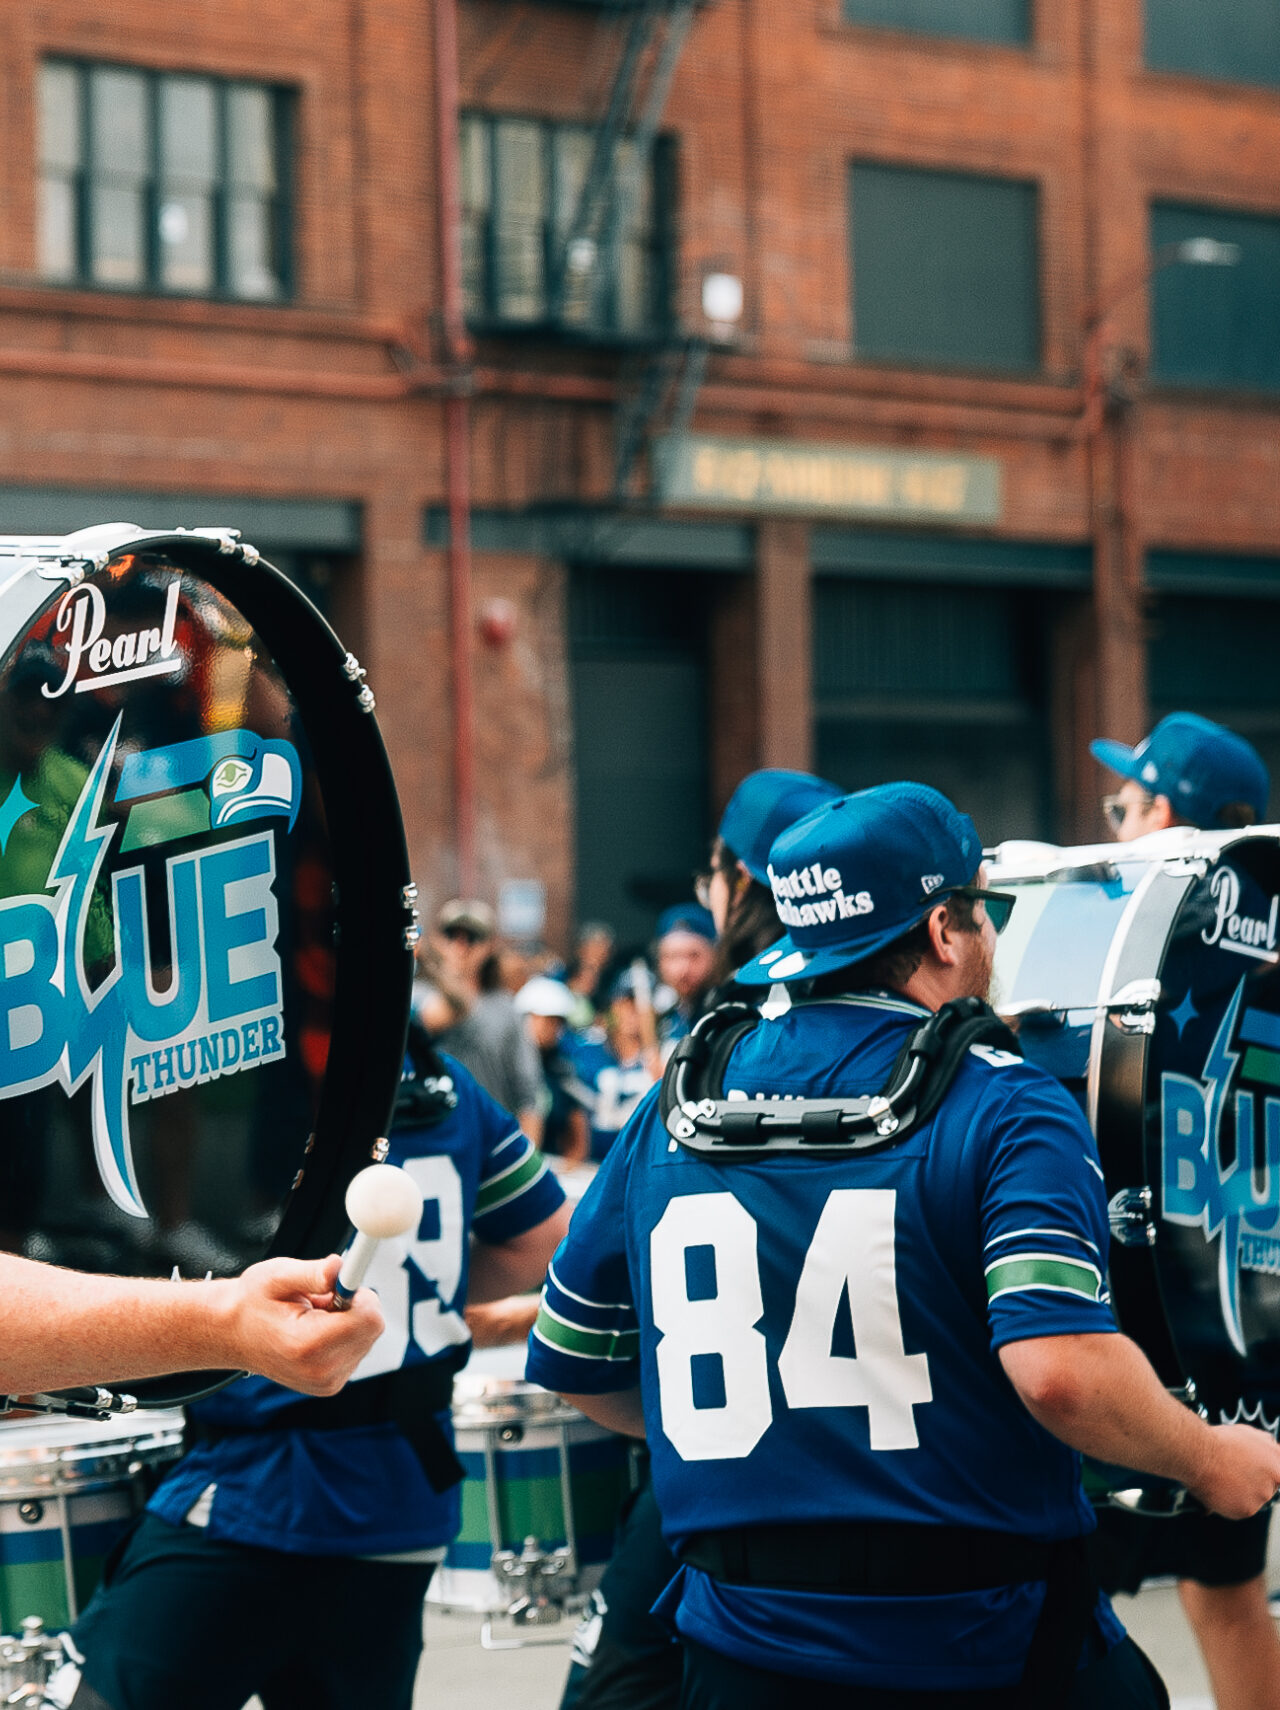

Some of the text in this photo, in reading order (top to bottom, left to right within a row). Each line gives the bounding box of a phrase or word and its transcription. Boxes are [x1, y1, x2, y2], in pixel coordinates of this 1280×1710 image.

[41, 580, 181, 698] Pearl
[767, 862, 842, 898] attle
[1201, 866, 1279, 952] Pearl
[131, 1015, 281, 1095] THUNDER
[650, 1188, 933, 1461] 84
